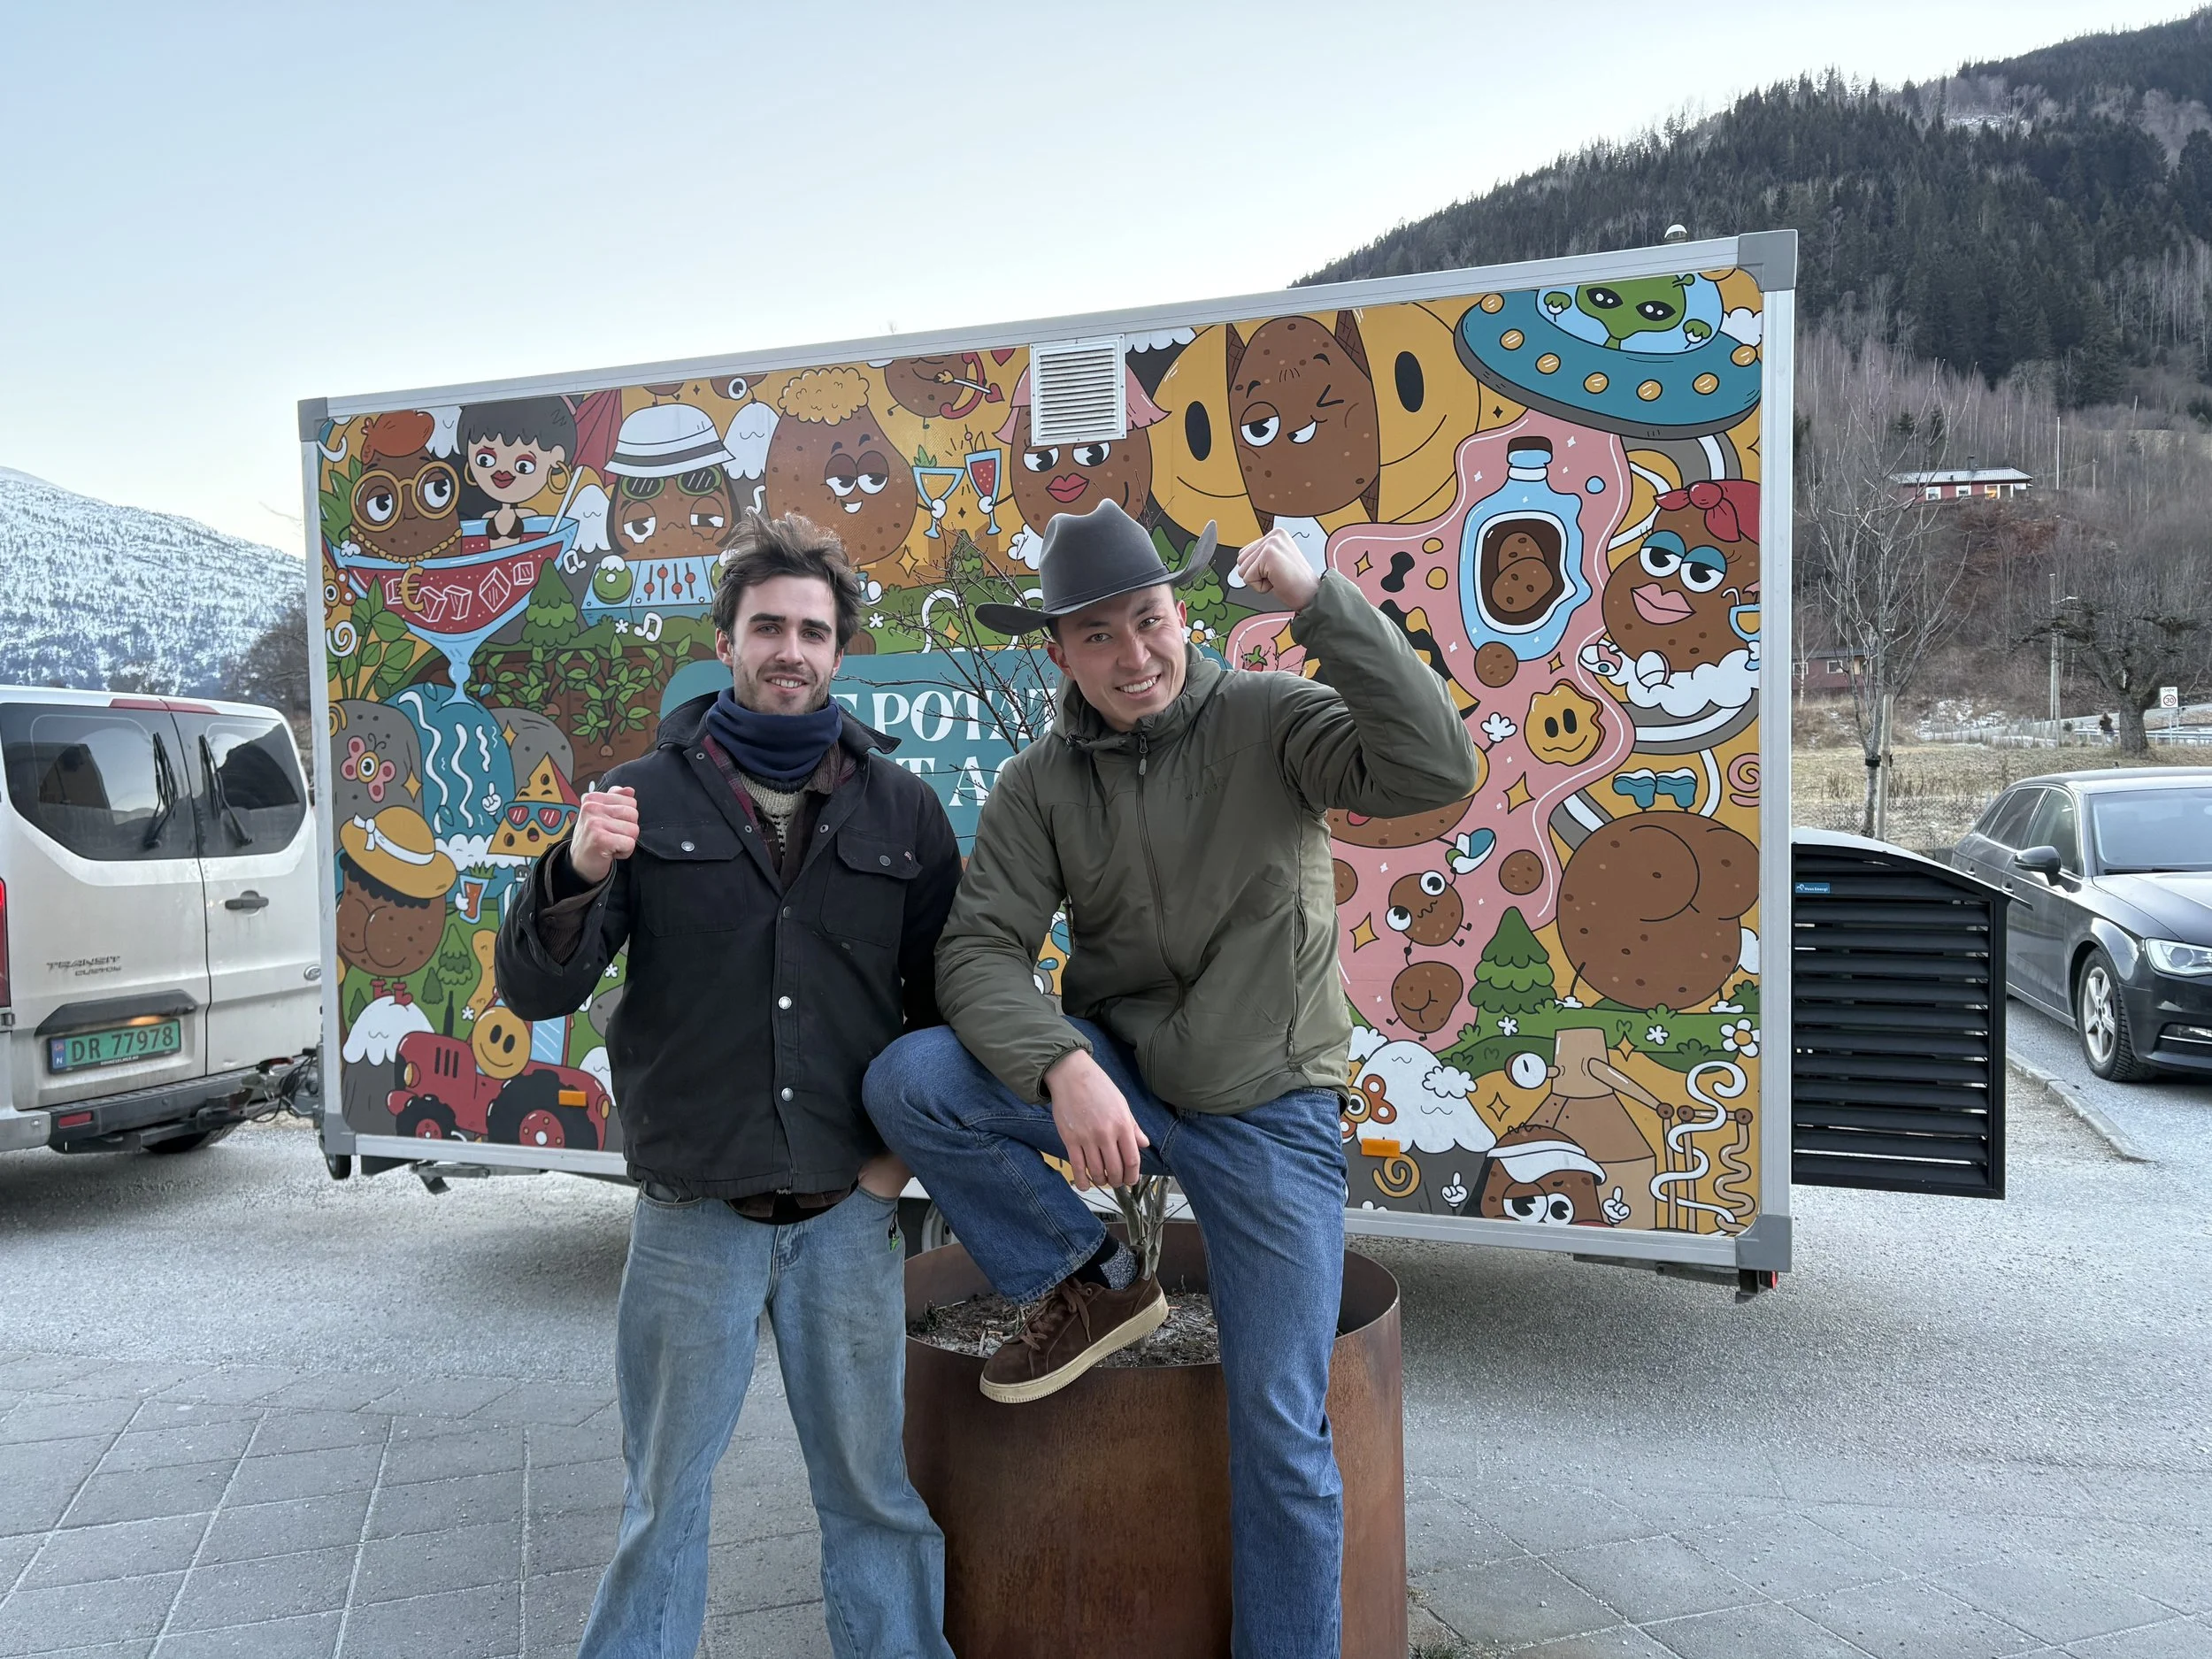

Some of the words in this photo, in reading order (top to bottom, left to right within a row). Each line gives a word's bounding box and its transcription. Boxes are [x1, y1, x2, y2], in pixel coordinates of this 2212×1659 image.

[46, 956, 120, 969] TRANSIT
[72, 1038, 101, 1063] DR
[111, 1026, 173, 1056] 77978
